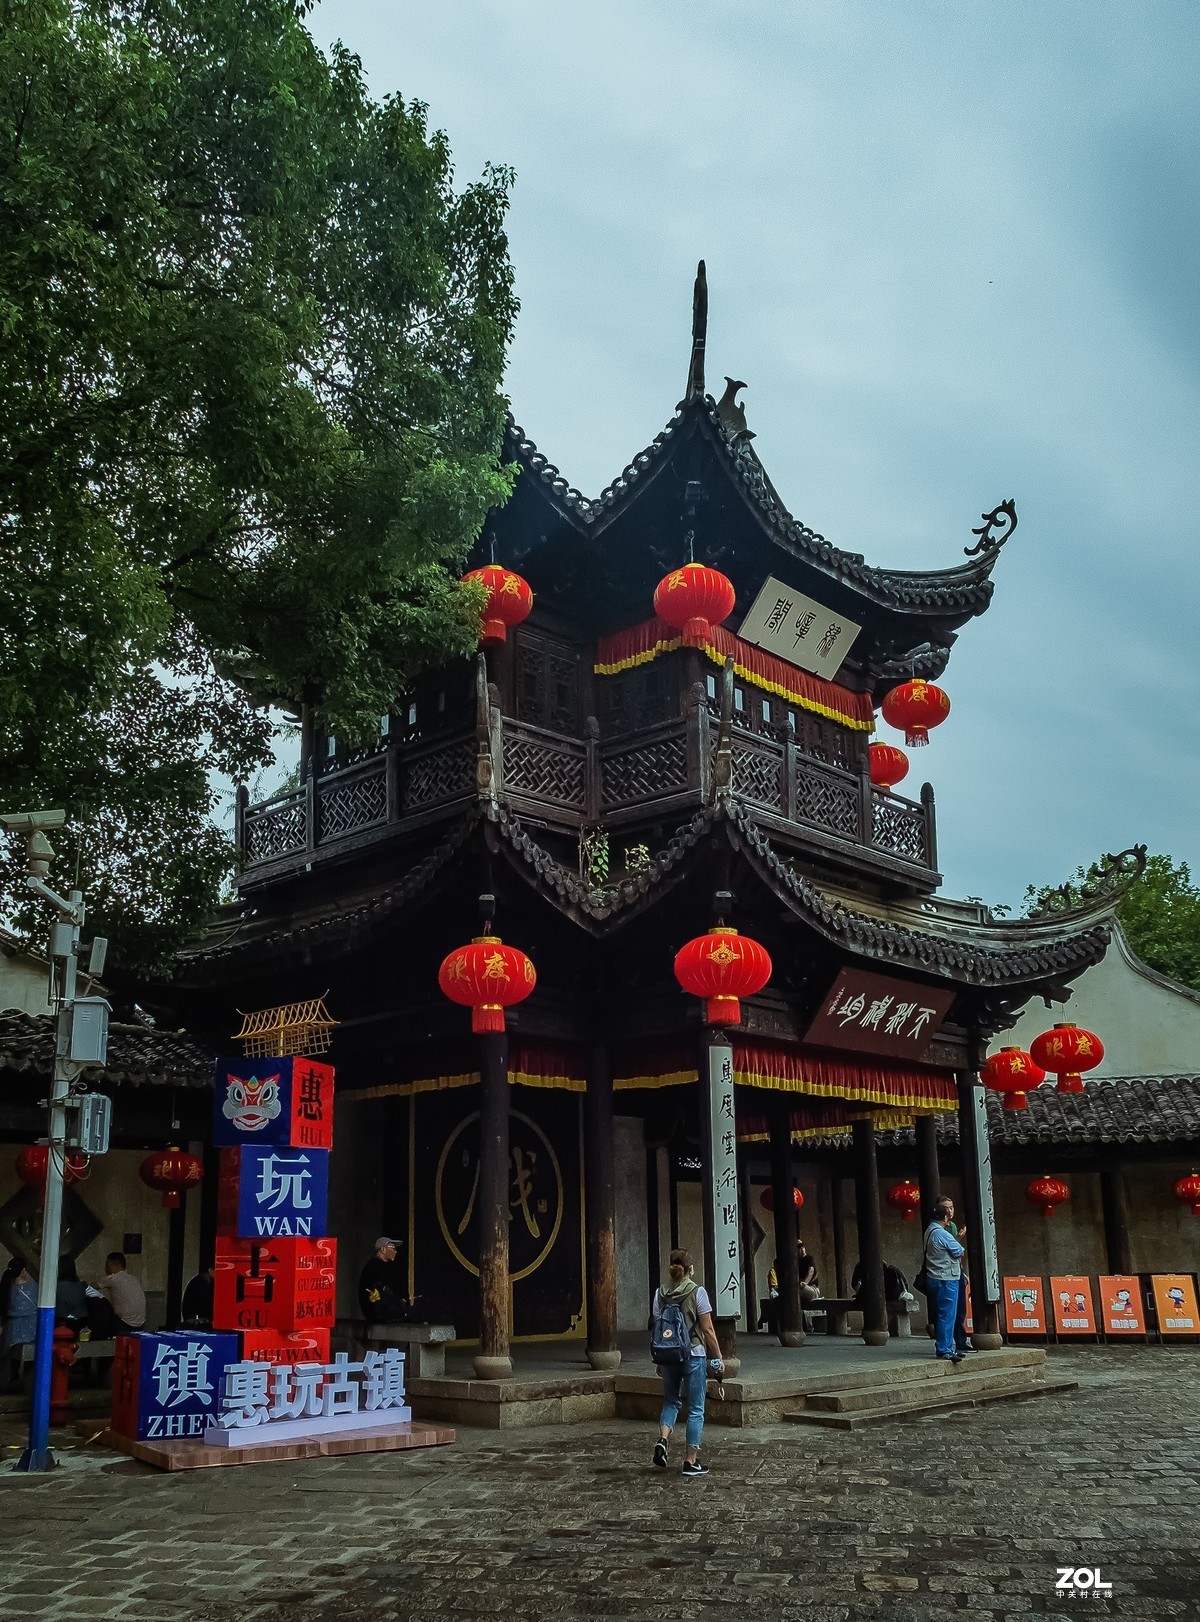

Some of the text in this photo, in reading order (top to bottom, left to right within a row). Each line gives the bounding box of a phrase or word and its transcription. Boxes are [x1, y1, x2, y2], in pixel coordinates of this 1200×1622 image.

[297, 1067, 324, 1121] 惠
[300, 1125, 323, 1147] HUI
[255, 1153, 313, 1211] 玩
[254, 1216, 314, 1236] WAN
[314, 1255, 333, 1268] WAN
[229, 1246, 280, 1304] 古
[297, 1276, 333, 1291] GU ZHEN
[237, 1308, 270, 1329] GU
[295, 1299, 333, 1320] 惠玩古镇
[284, 1347, 324, 1362] WAN
[151, 1341, 215, 1408] 镇
[218, 1348, 405, 1428] 惠玩古镇
